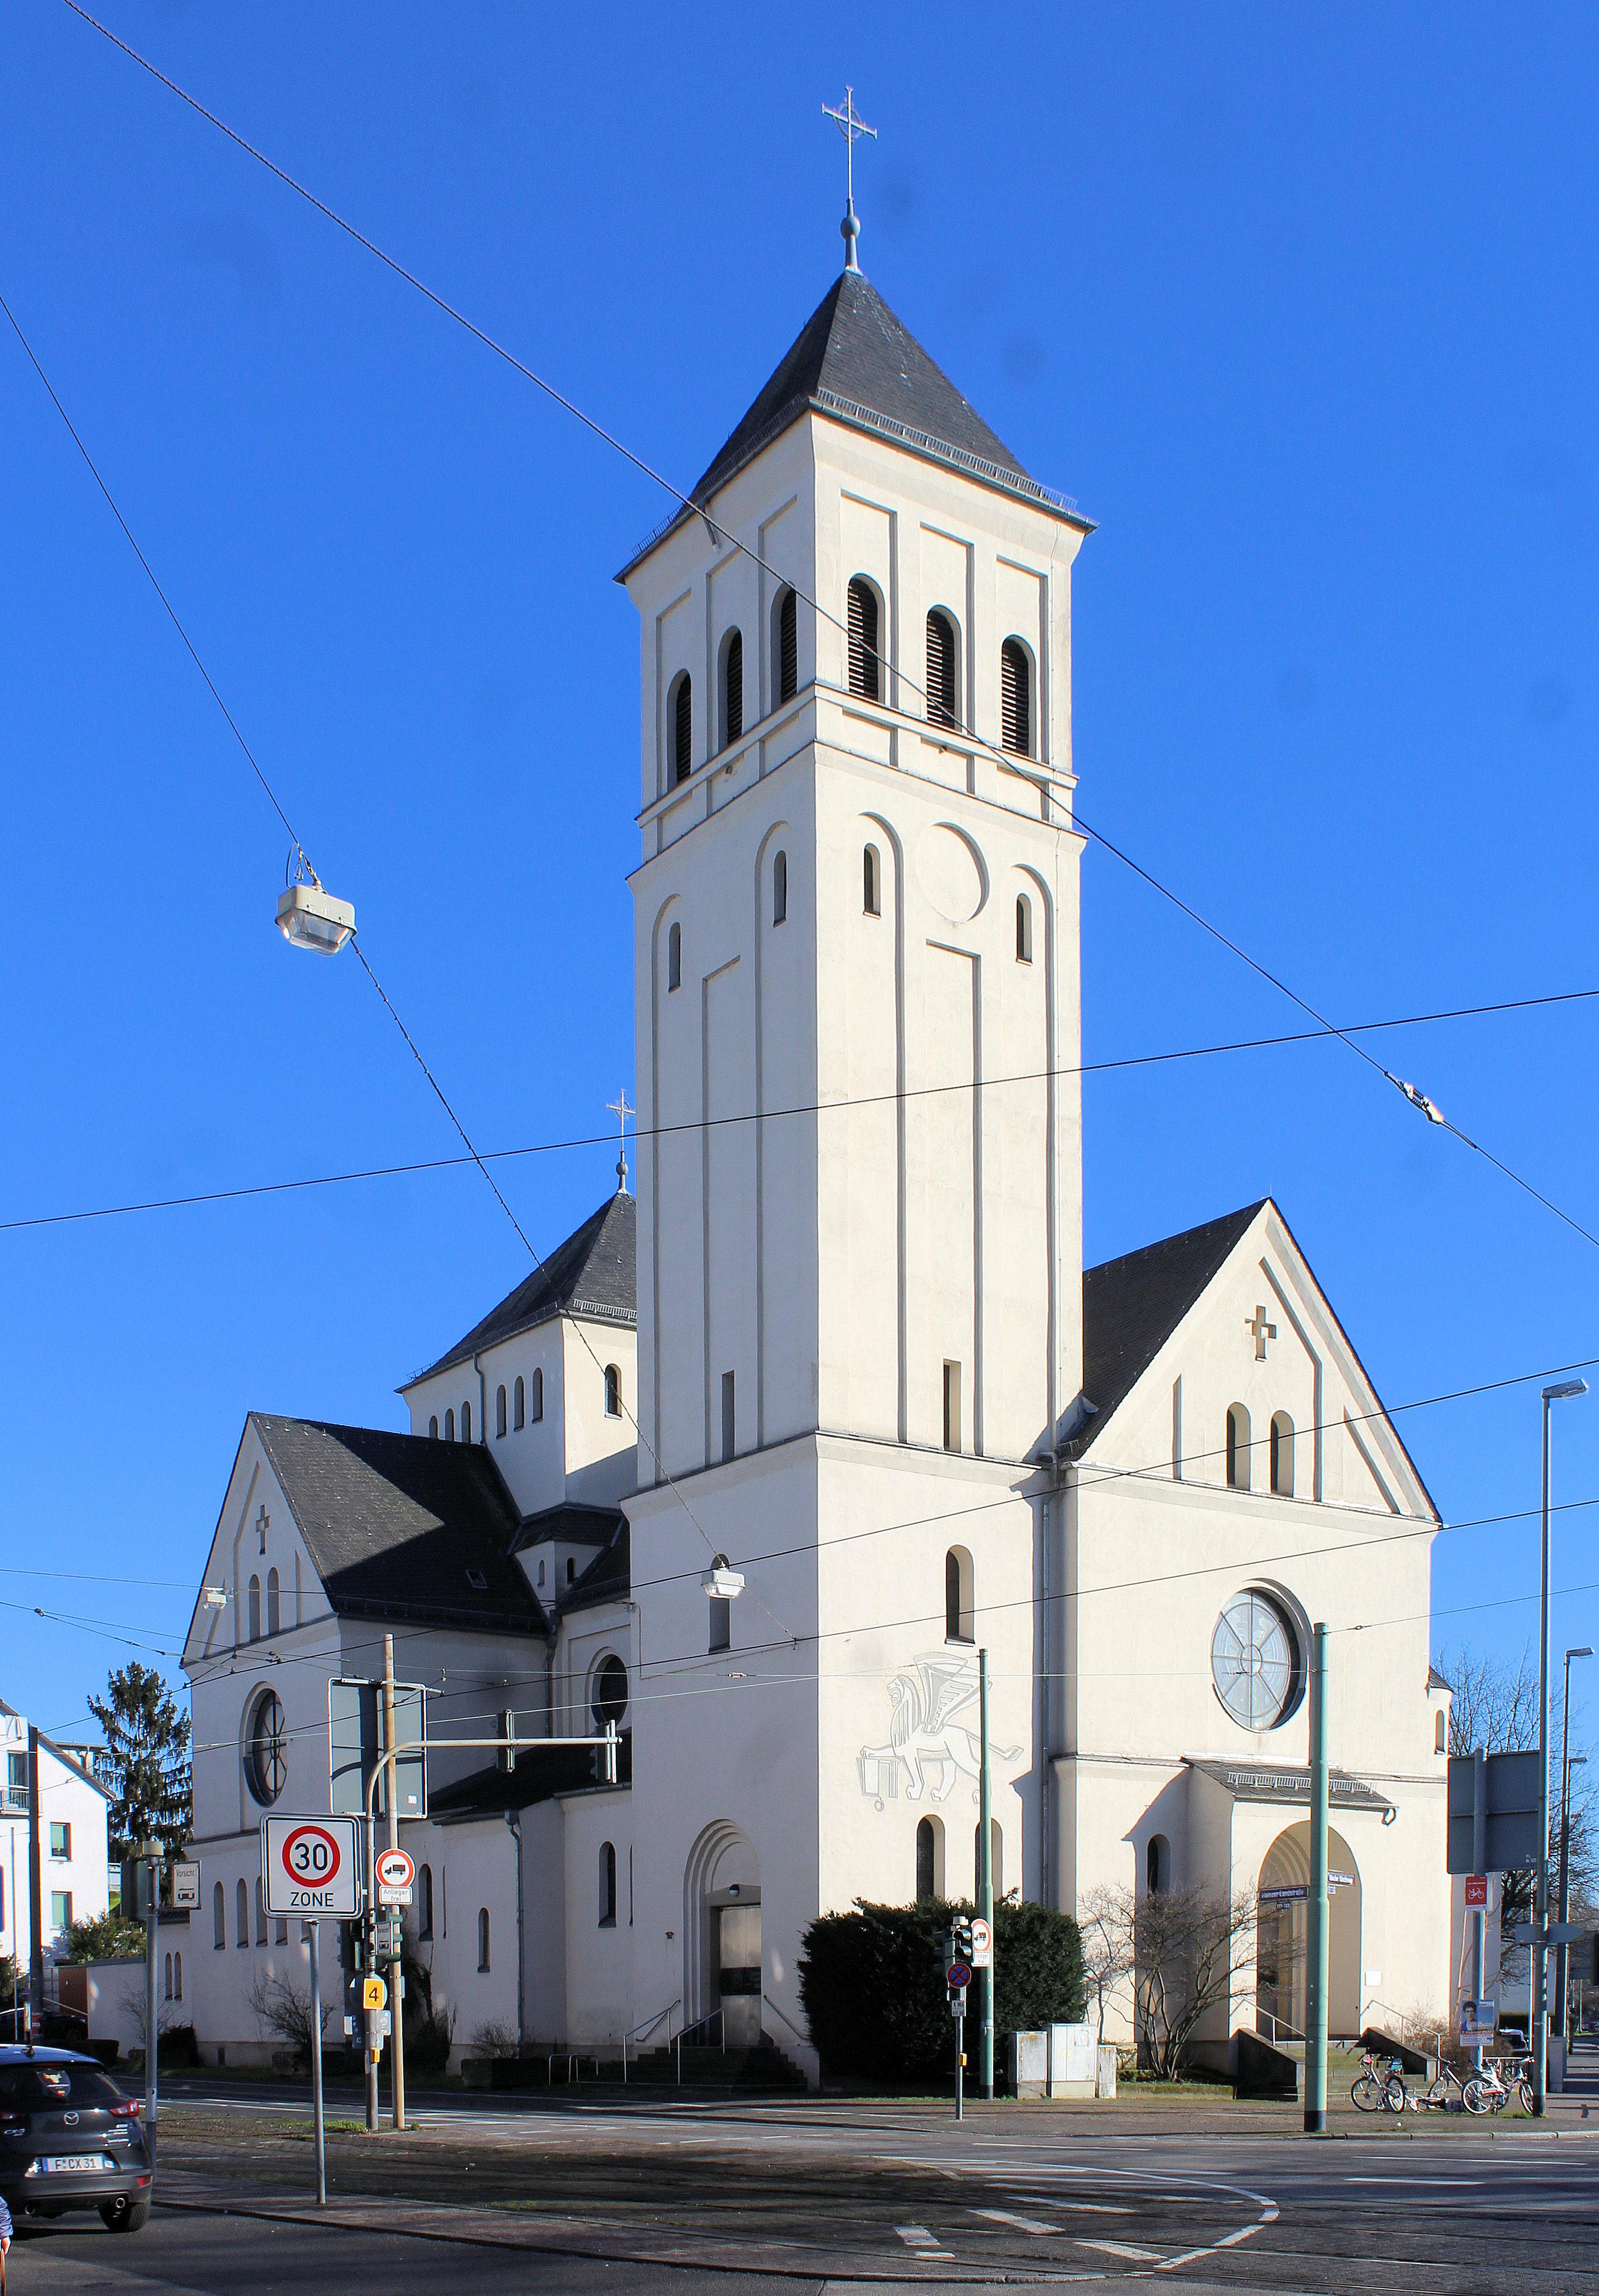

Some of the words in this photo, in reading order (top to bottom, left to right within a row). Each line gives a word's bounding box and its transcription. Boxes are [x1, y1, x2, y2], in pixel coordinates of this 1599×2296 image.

[295, 1842, 328, 1871] 30
[291, 1891, 334, 1907] ZONE
[368, 1987, 378, 2002] 4
[56, 2159, 61, 2170] F
[68, 2158, 82, 2170] CX
[84, 2157, 97, 2169] 31
